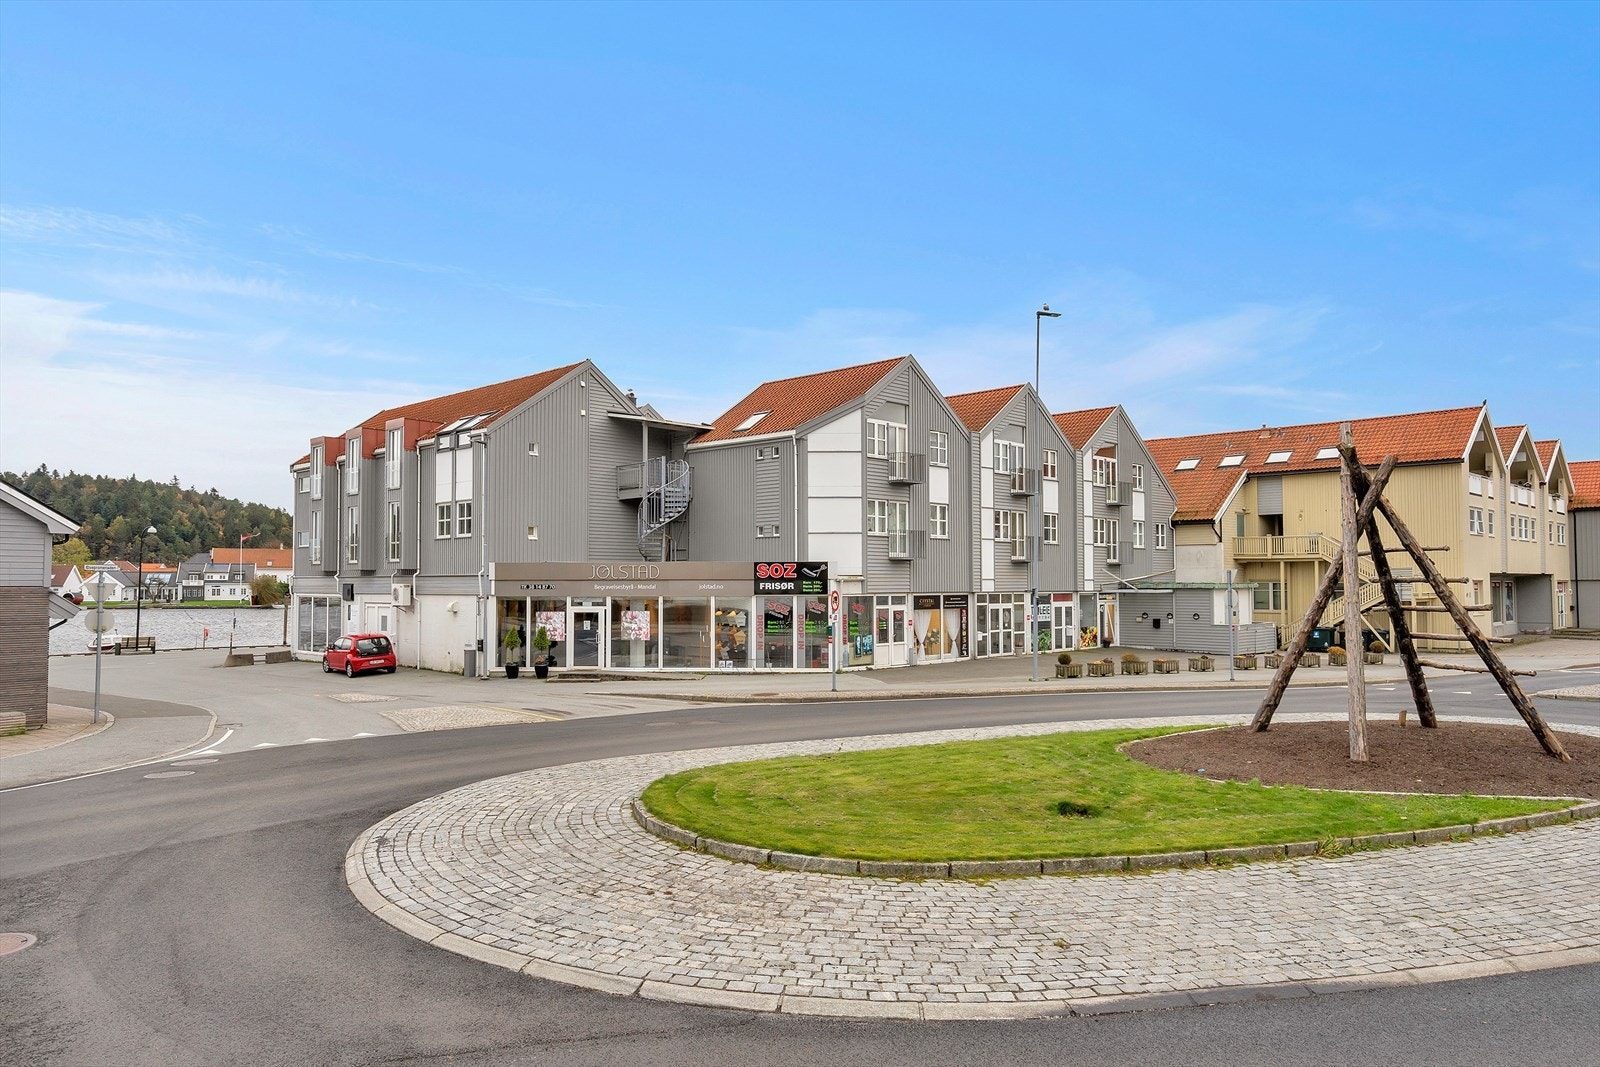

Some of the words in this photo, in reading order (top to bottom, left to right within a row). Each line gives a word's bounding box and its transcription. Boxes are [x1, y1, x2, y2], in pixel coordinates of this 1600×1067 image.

[588, 564, 660, 580] JØLSTAD
[756, 563, 797, 578] SOZ
[768, 601, 790, 615] SOZ
[808, 600, 826, 612] SOZ
[757, 642, 763, 651] IN
[798, 641, 804, 650] IN
